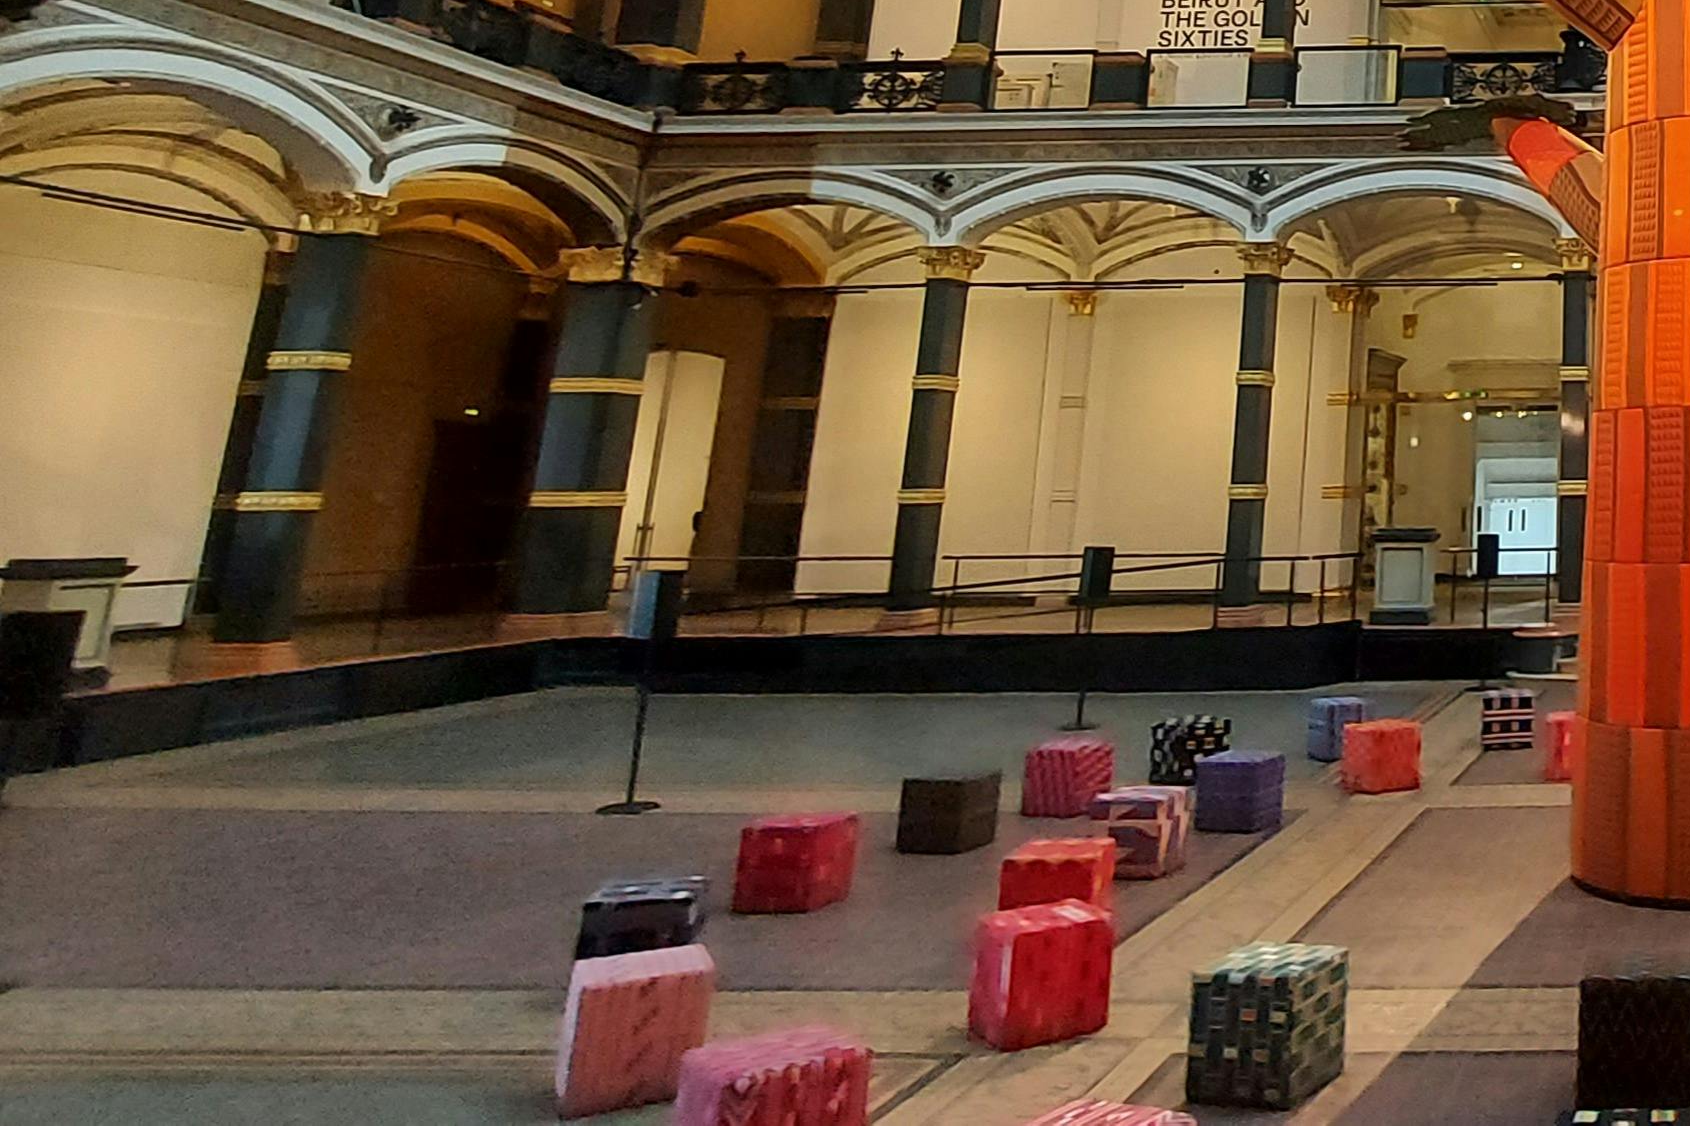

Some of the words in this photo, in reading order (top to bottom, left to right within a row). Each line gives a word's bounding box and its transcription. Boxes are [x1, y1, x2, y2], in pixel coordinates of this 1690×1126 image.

[1160, 11, 1207, 28] THE
[1213, 9, 1309, 27] GOLN
[1158, 29, 1248, 47] SIXTIES
